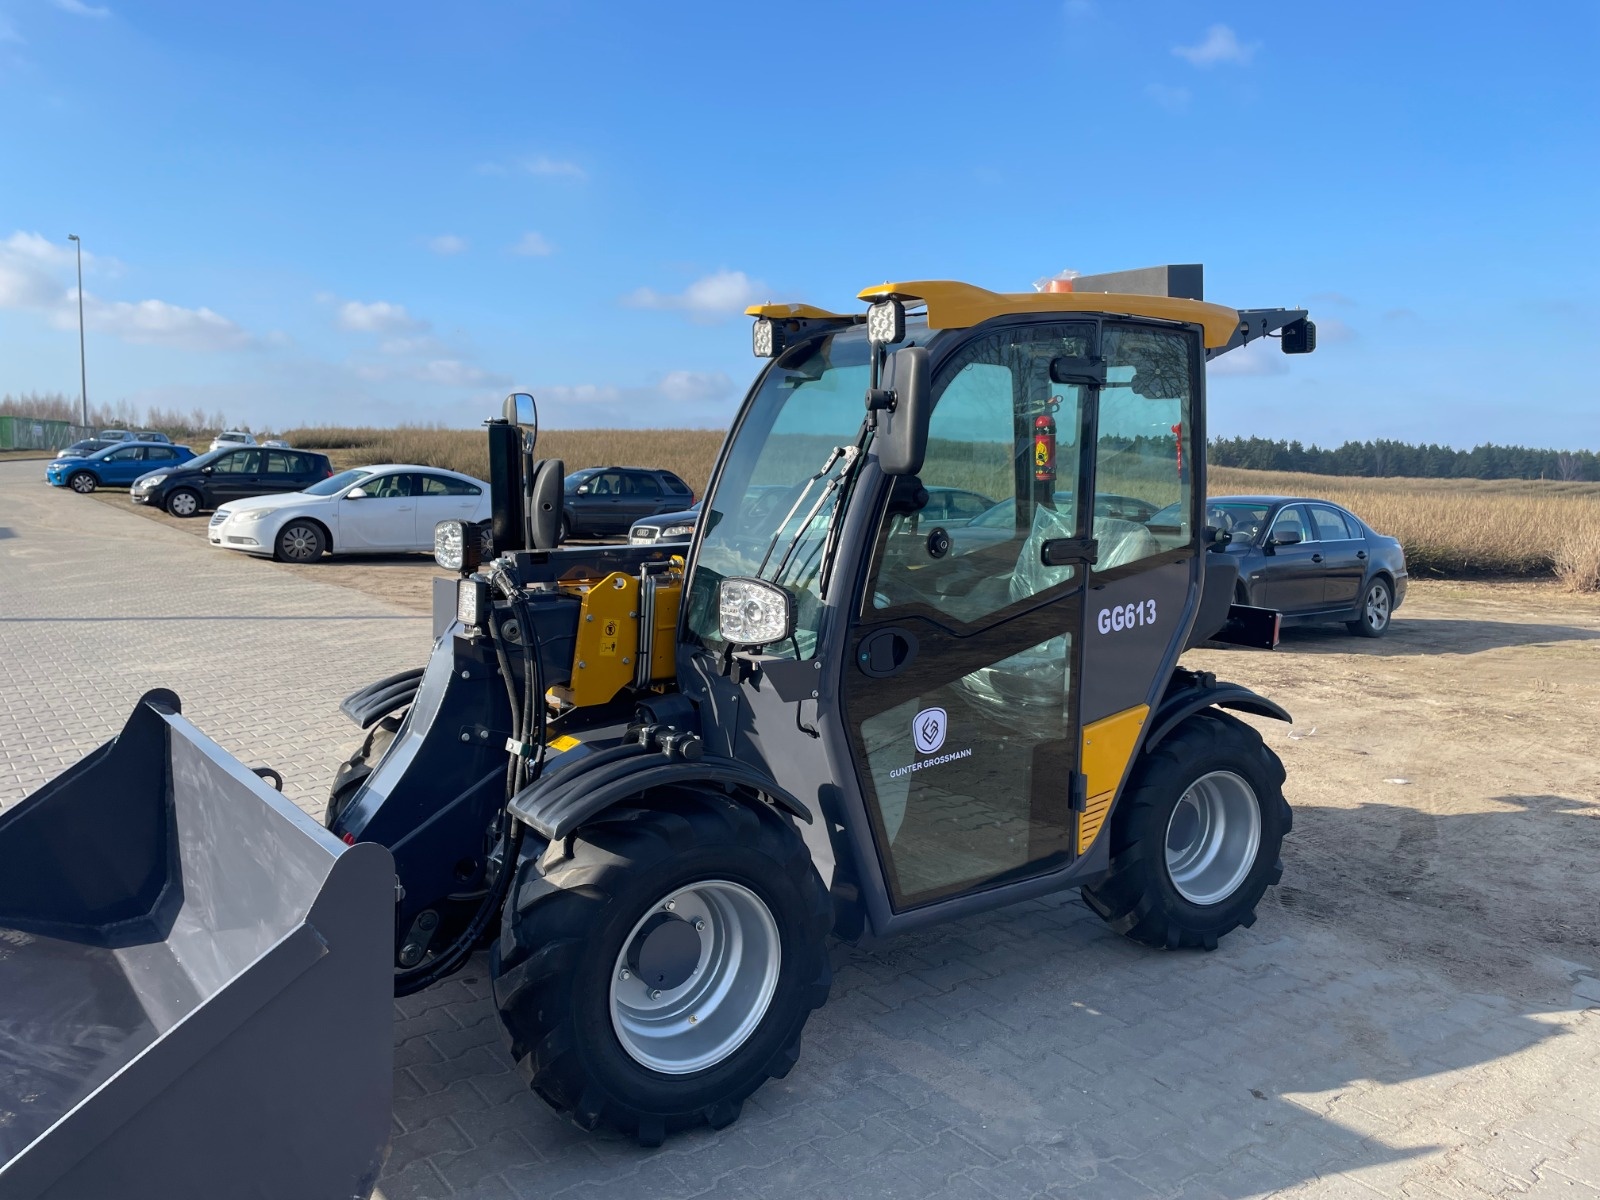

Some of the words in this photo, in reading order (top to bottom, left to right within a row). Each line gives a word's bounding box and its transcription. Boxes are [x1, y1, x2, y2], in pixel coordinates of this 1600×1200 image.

[1098, 599, 1156, 634] GG613
[889, 761, 922, 778] GUNTER
[923, 748, 972, 768] GROSSMANN
